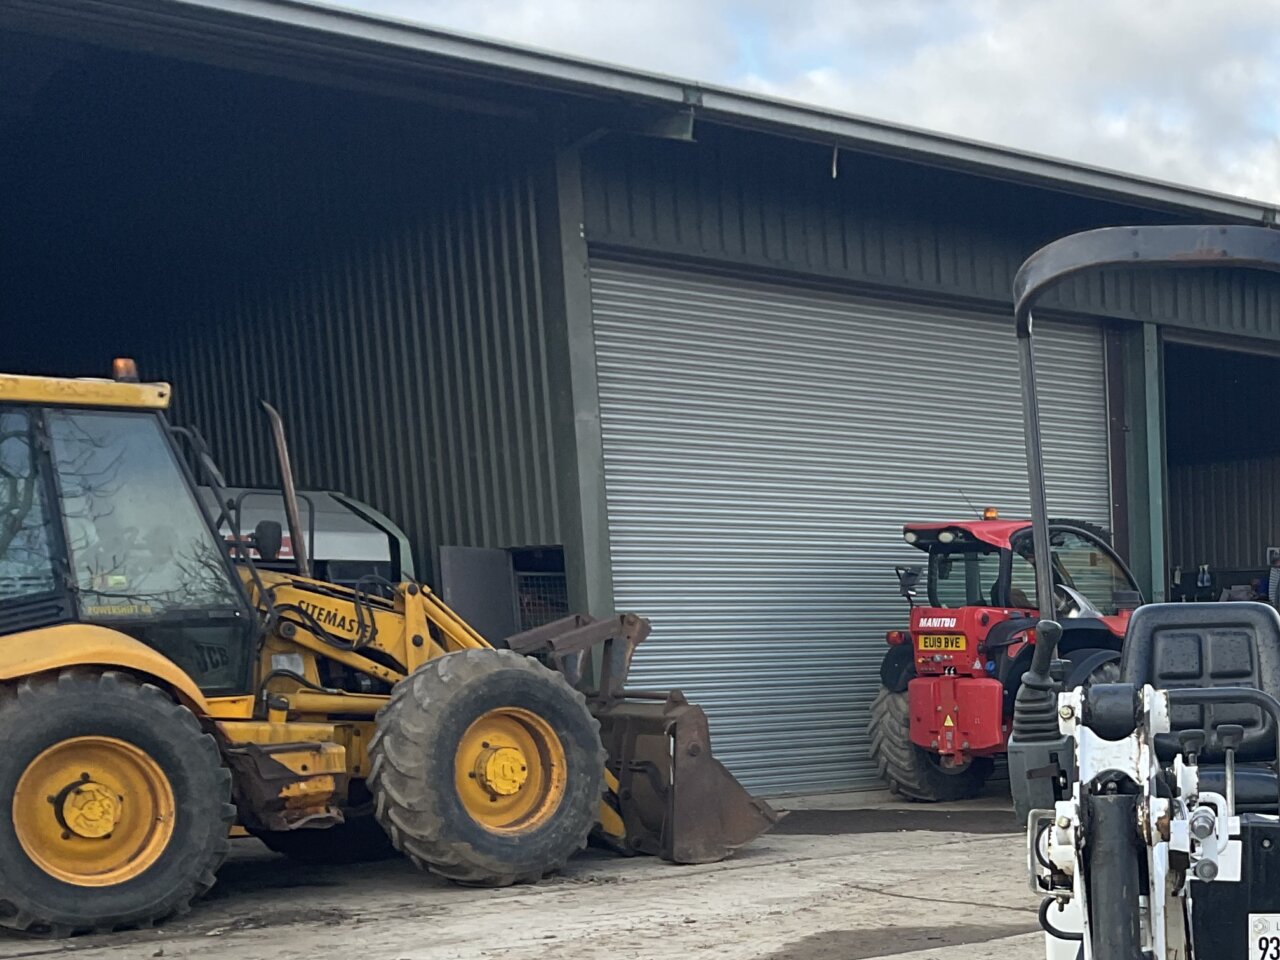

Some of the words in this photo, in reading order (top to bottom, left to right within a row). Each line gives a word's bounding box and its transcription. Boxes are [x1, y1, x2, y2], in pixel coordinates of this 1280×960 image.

[298, 600, 379, 646] SITEMASTE
[919, 617, 957, 628] MANITOU
[923, 636, 942, 648] EU19
[944, 636, 961, 648] BVE
[195, 645, 230, 672] JCB
[1258, 936, 1280, 960] 93
